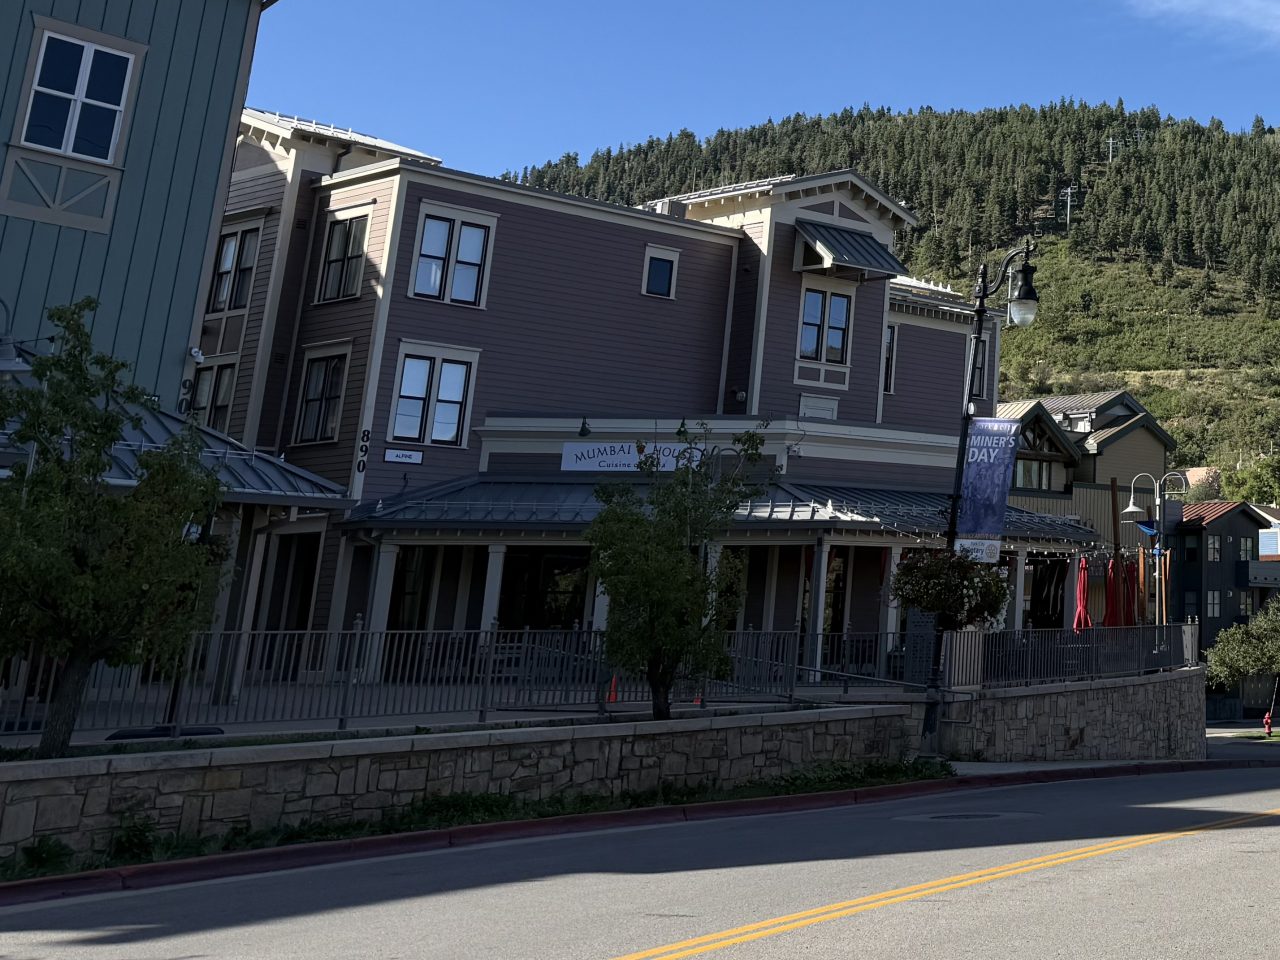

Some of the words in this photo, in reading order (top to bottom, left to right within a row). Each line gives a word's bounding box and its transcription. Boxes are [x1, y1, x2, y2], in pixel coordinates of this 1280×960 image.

[970, 435, 1016, 448] MINER'S
[357, 429, 371, 473] 890
[574, 444, 632, 464] MUMBAI
[968, 448, 999, 463] DAY
[598, 460, 632, 469] Cuisine
